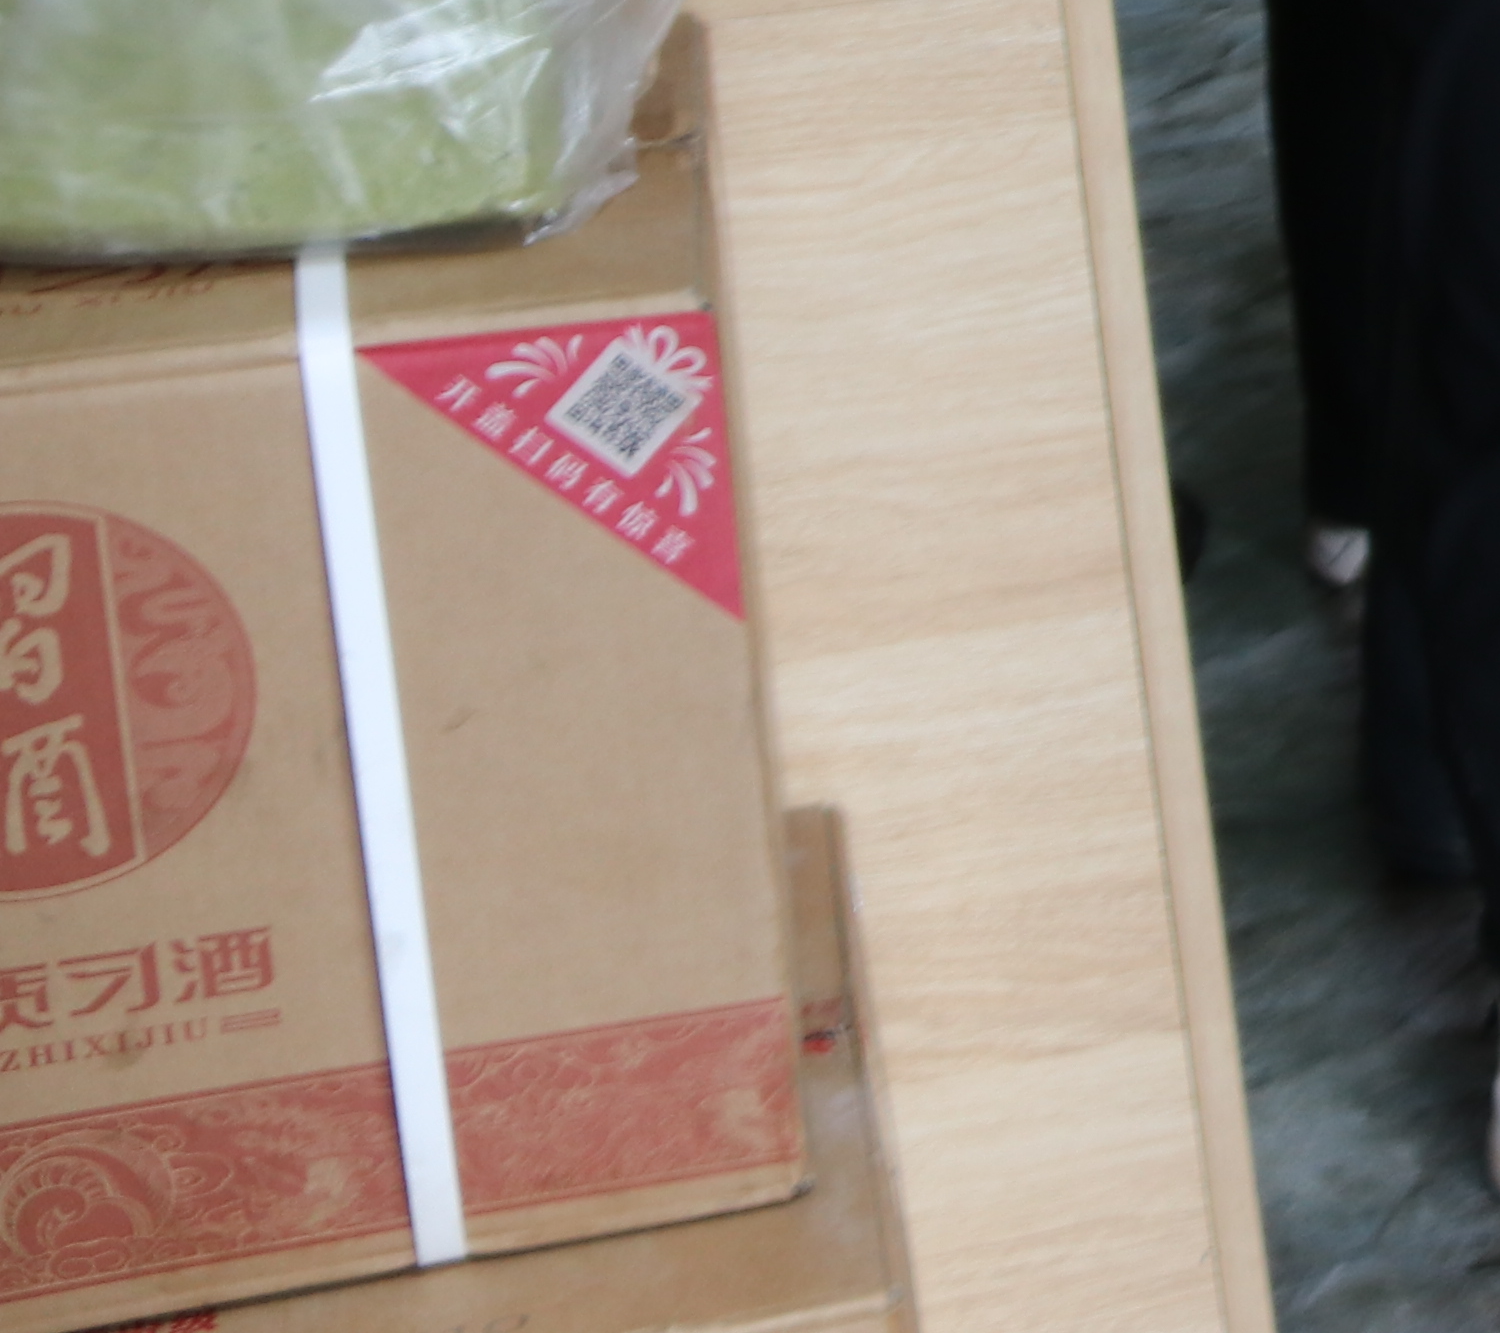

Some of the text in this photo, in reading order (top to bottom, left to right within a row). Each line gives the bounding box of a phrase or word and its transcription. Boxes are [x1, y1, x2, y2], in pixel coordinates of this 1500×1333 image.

[435, 373, 696, 565] 开盖扫码有惊喜
[0, 1016, 209, 1073] ZHIXIJIU
